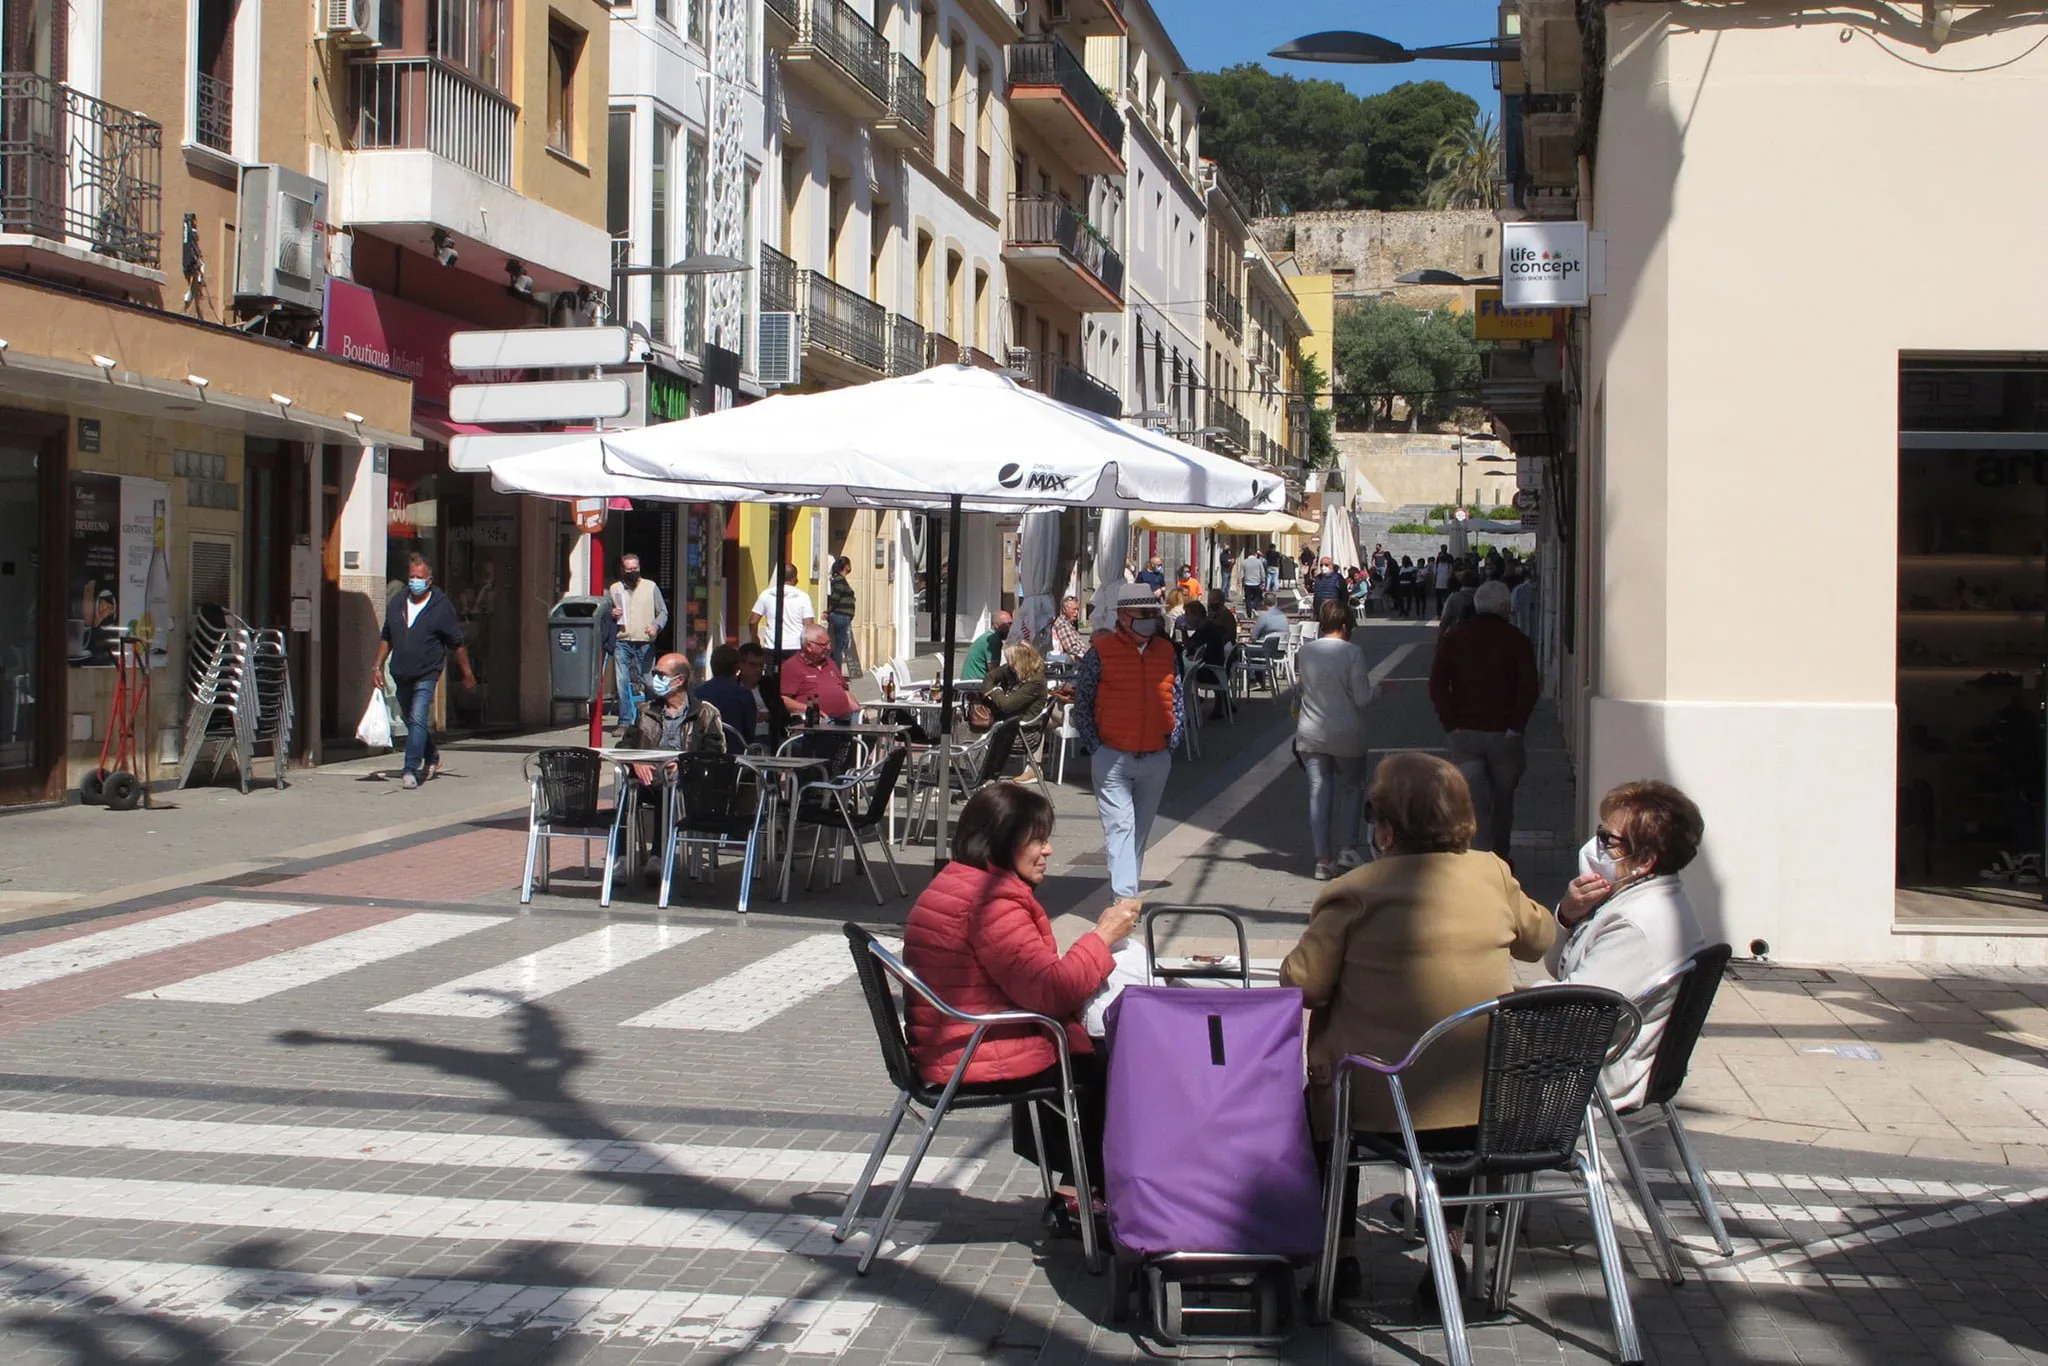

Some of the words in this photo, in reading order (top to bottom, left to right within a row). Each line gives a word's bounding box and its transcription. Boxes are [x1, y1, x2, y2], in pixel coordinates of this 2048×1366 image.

[1510, 248, 1536, 262] life
[1510, 260, 1580, 280] concept
[343, 335, 390, 368] Boutique
[391, 349, 424, 377] Infantil
[1026, 471, 1076, 492] MAX
